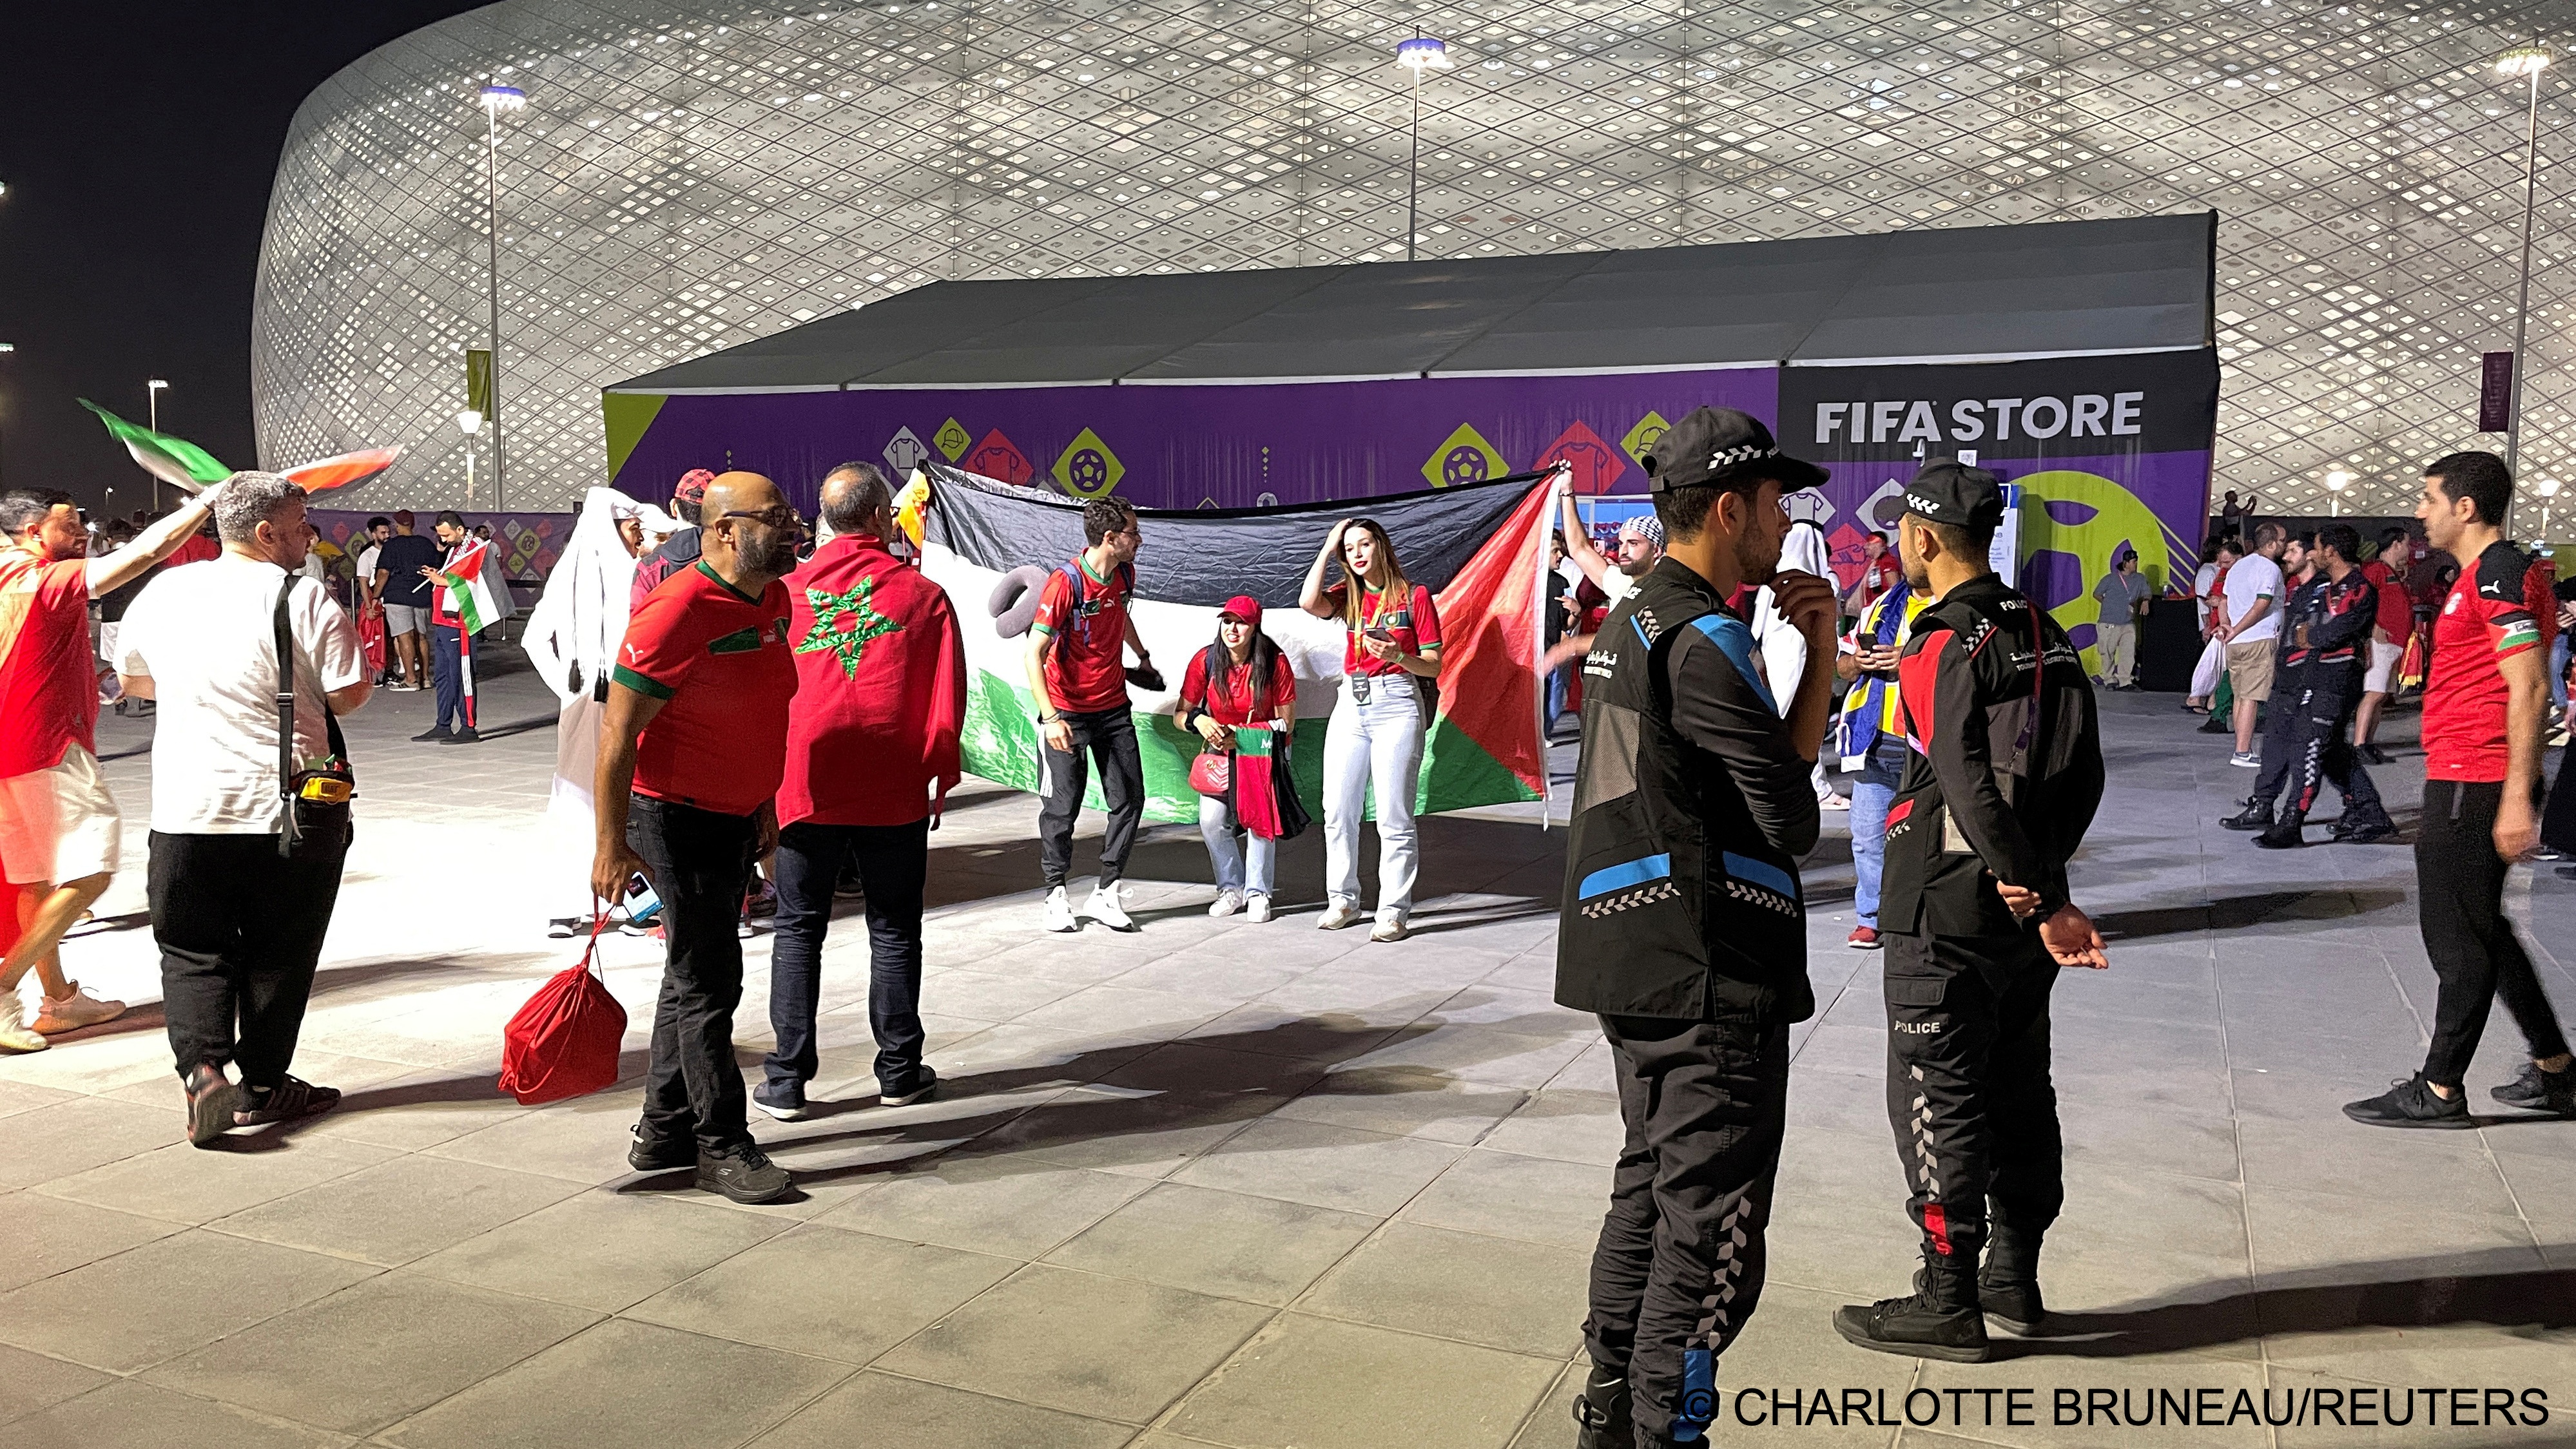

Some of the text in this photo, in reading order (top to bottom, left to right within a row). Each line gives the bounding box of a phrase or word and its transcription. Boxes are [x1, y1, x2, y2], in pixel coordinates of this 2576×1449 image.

[1816, 391, 2144, 444] FIFA STORE
[1999, 599, 2028, 611] POLIC
[1260, 738, 1272, 749] M
[1893, 1020, 1941, 1034] POLICE
